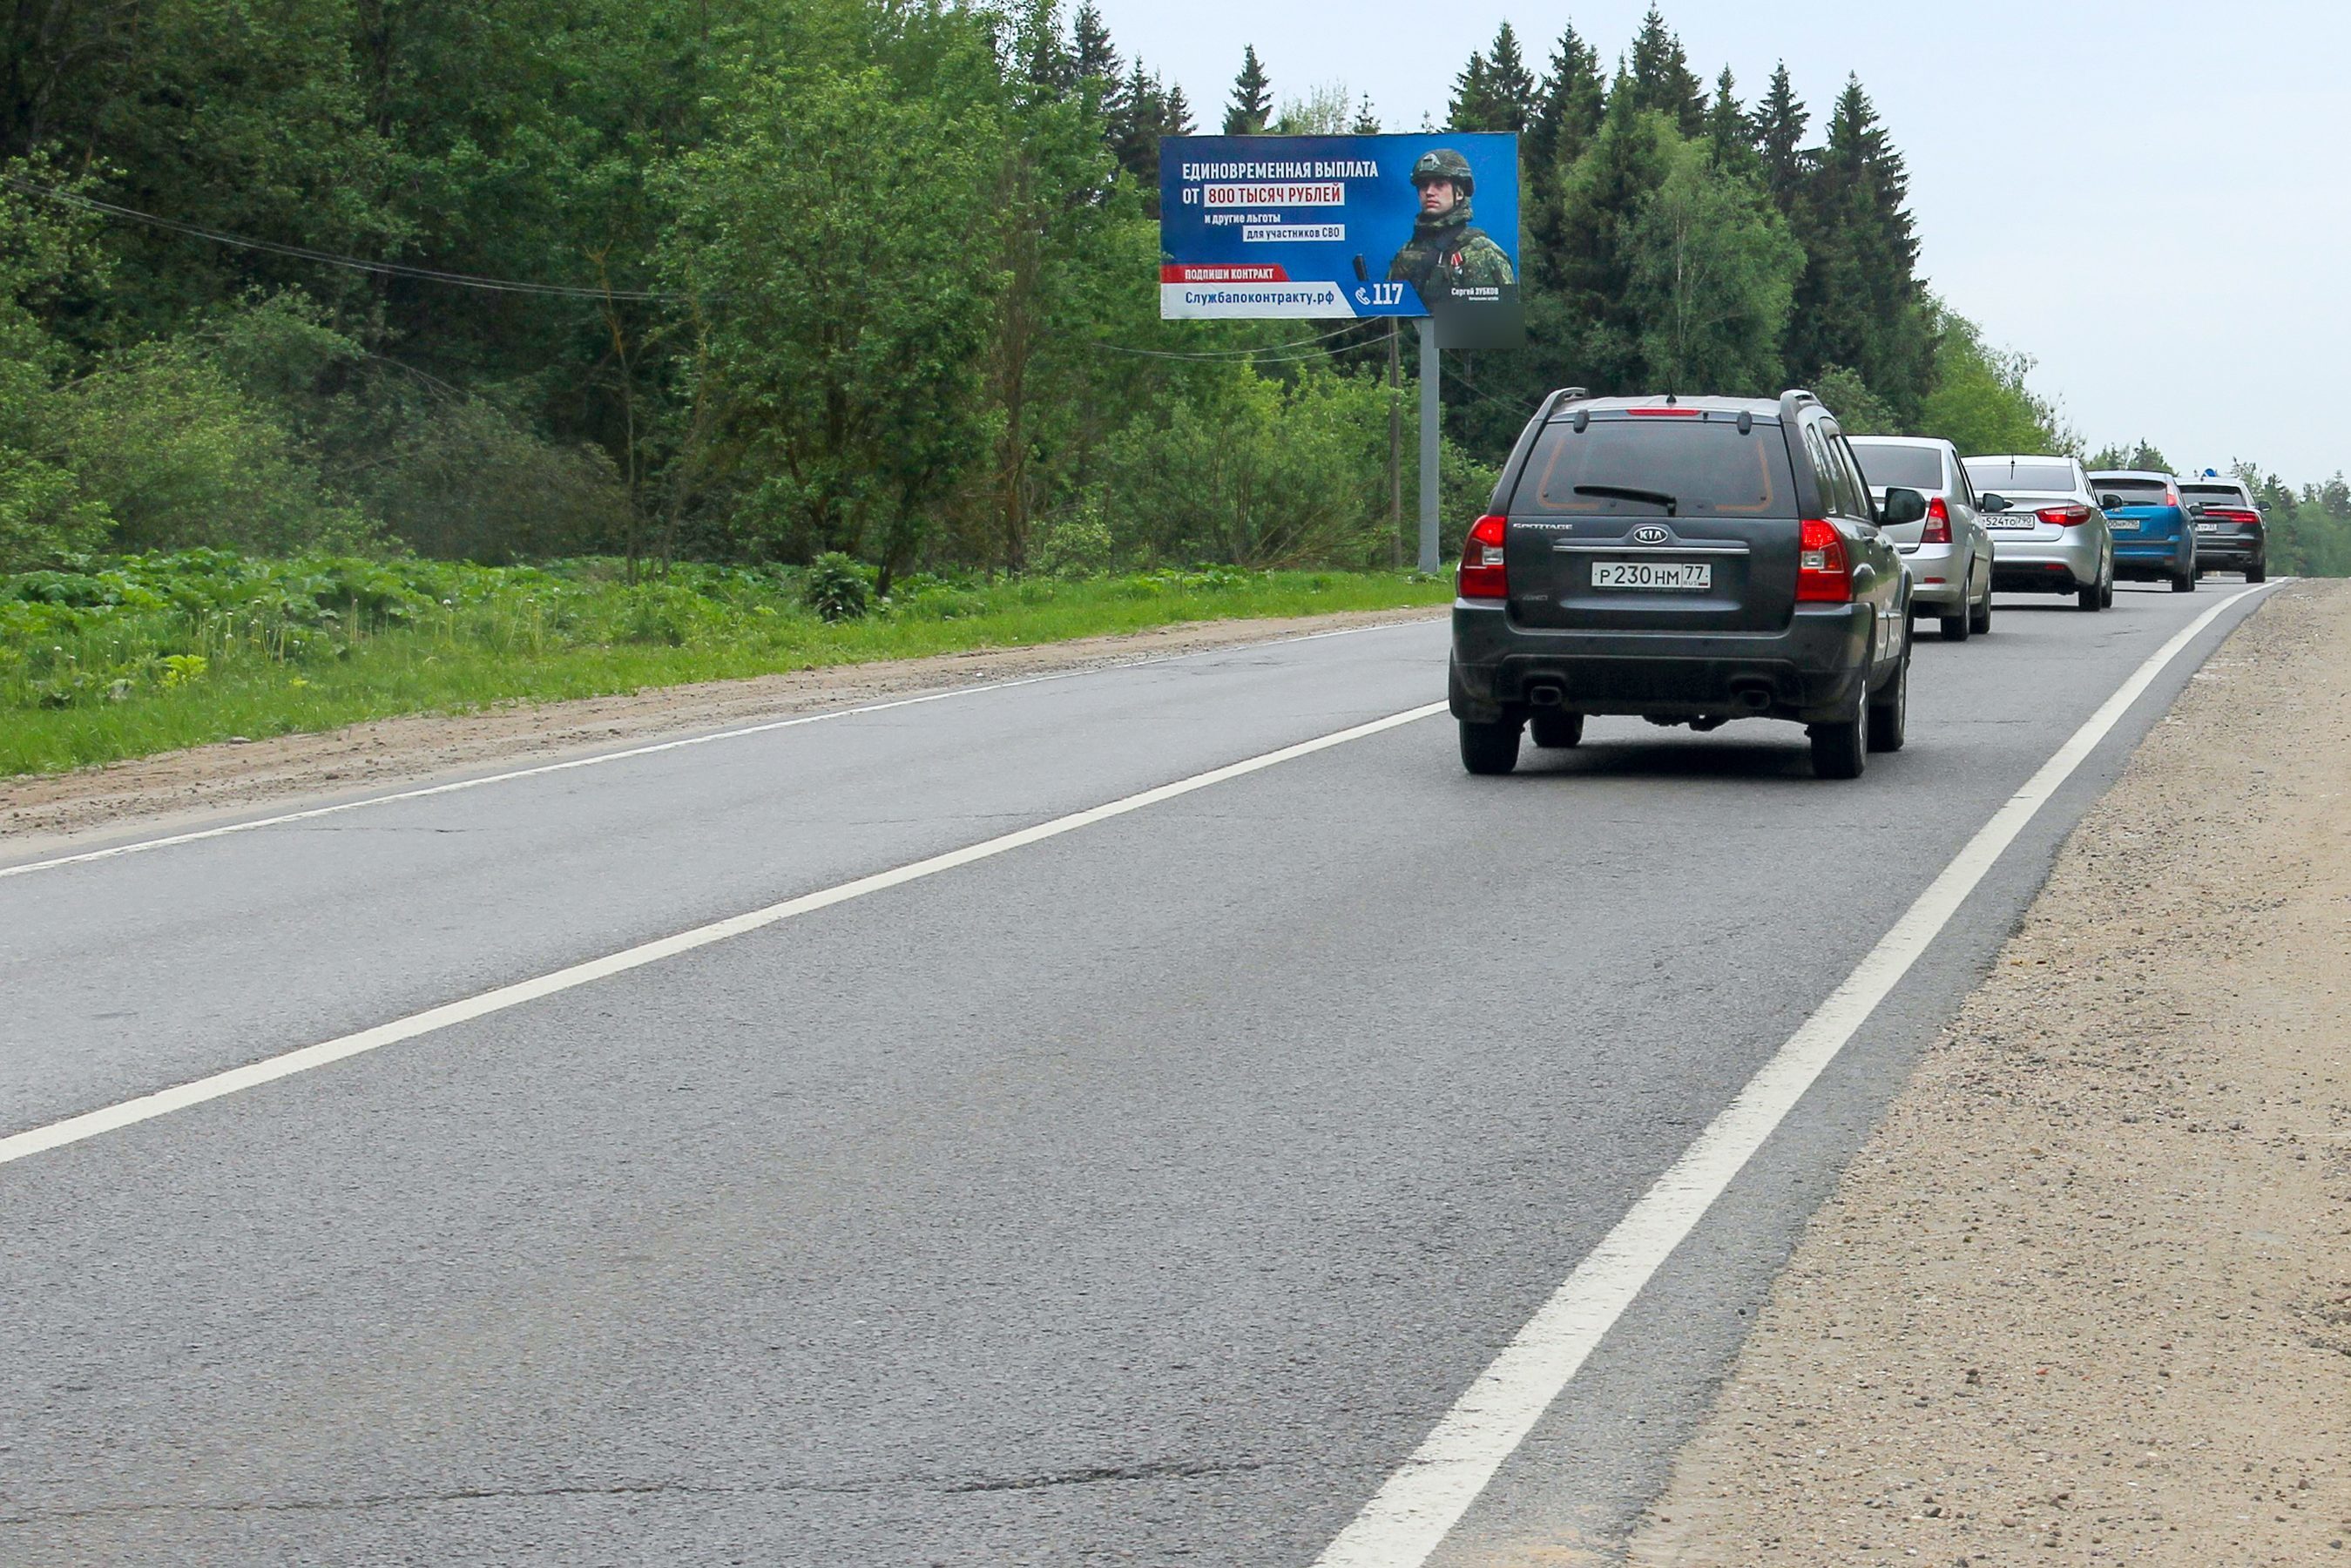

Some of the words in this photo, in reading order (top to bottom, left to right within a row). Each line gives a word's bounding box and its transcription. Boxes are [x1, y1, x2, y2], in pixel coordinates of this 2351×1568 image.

[1182, 162, 1311, 181] ЕДИНОВРЕМЕННАЯ
[1314, 160, 1379, 179] ВЫПЛАТА
[1182, 187, 1200, 205] ОТ
[1208, 187, 1235, 204] 800
[1239, 187, 1285, 204] ТЫСЯЧ
[1288, 182, 1341, 203] РУБЛЕЙ
[1205, 214, 1211, 224] и
[1212, 214, 1245, 226] другие
[1246, 213, 1281, 224] льготы
[1246, 229, 1264, 240] для
[1266, 228, 1321, 240] участников
[1321, 226, 1340, 239] СВО
[1185, 268, 1229, 281] ПОДПИШИ
[1231, 267, 1274, 280] КОНТРАКТ
[1186, 290, 1335, 306] Службапоконтракту.рф
[1373, 282, 1404, 305] 117
[1450, 287, 1475, 297] Сергей
[1638, 530, 1662, 540] KIA
[1685, 565, 1705, 580] 77
